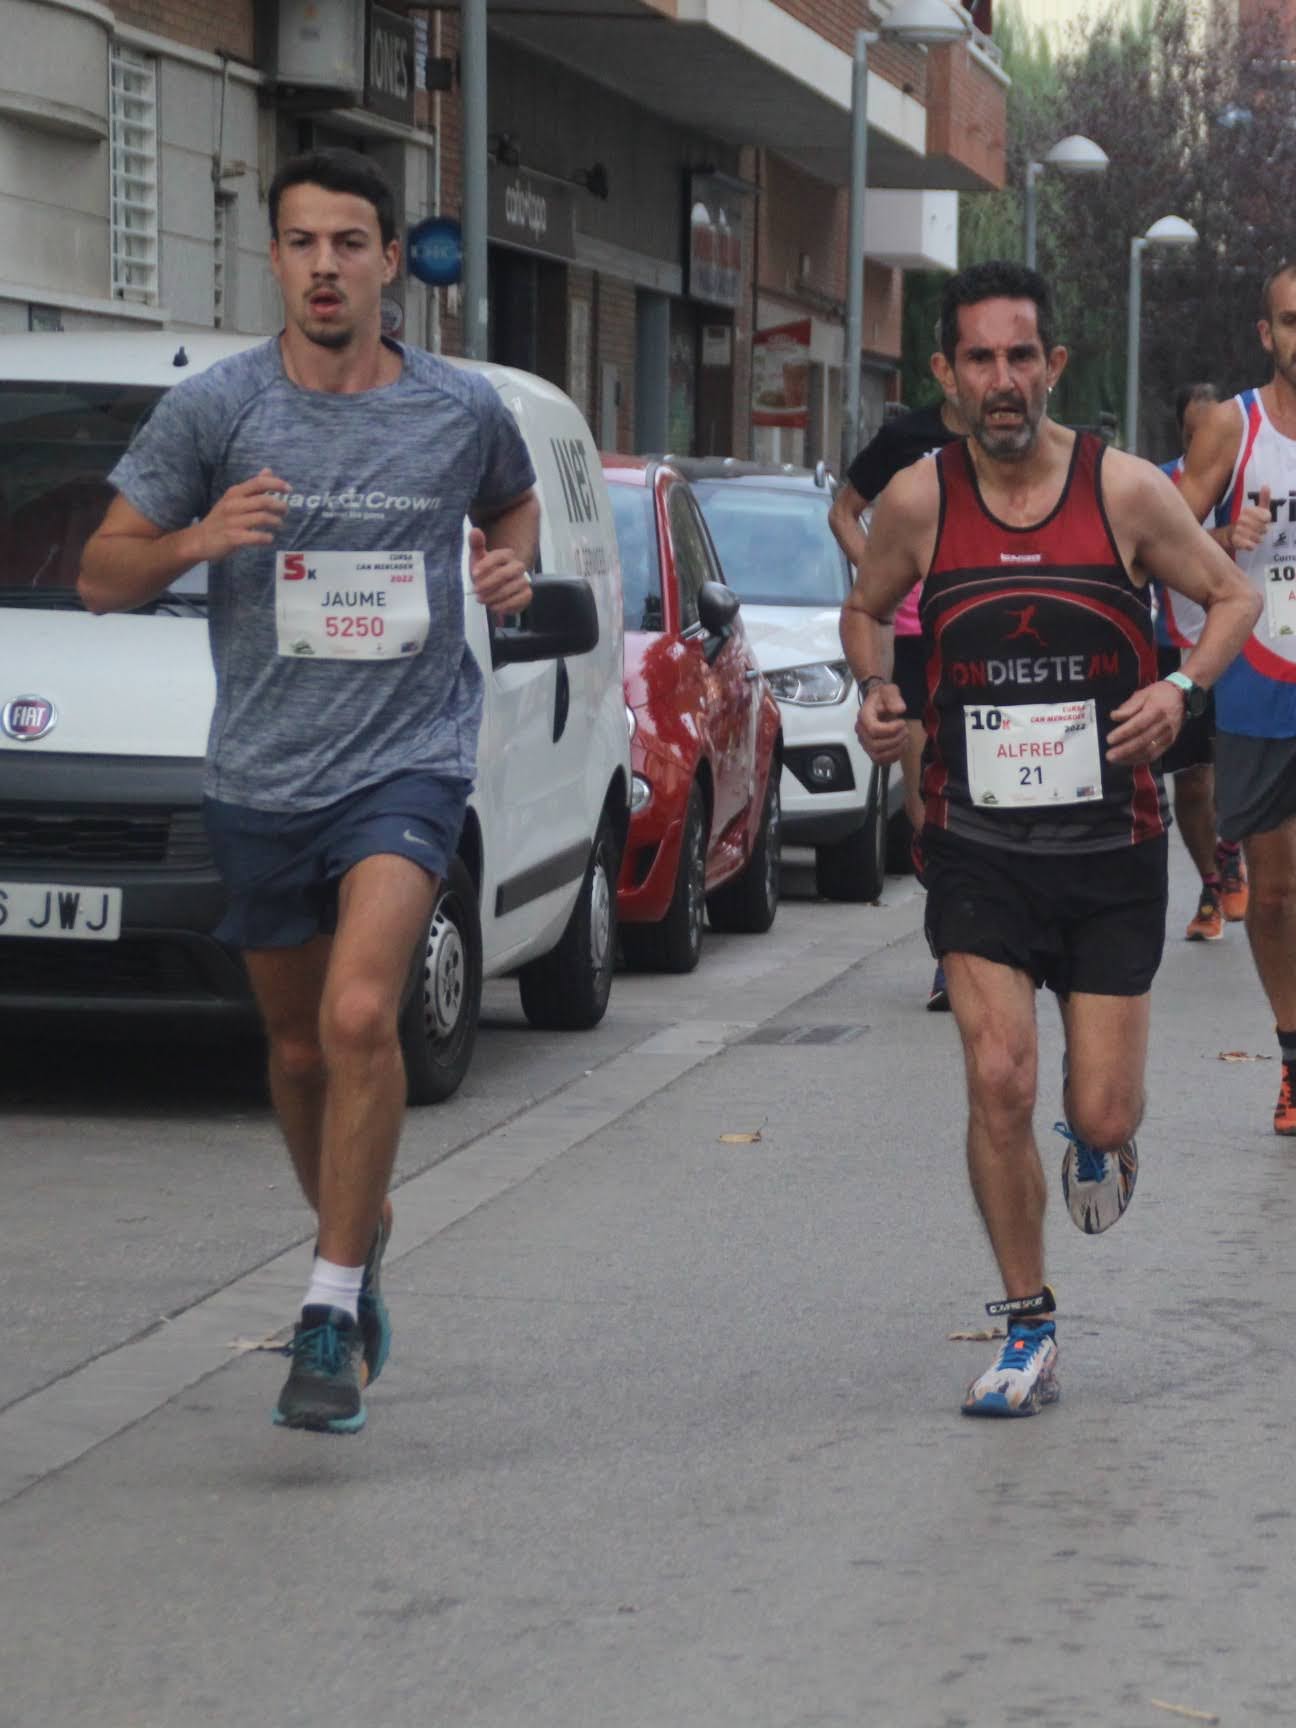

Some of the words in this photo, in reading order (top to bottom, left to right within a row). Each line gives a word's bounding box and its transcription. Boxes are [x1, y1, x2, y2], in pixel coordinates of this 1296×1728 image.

[391, 575, 414, 583] 2022
[321, 591, 387, 607] JAUME
[325, 616, 385, 637] 5250
[12, 706, 47, 726] FIAT
[996, 741, 1065, 758] ALFRED
[1019, 765, 1043, 785] 21
[28, 891, 109, 931] JWJ
